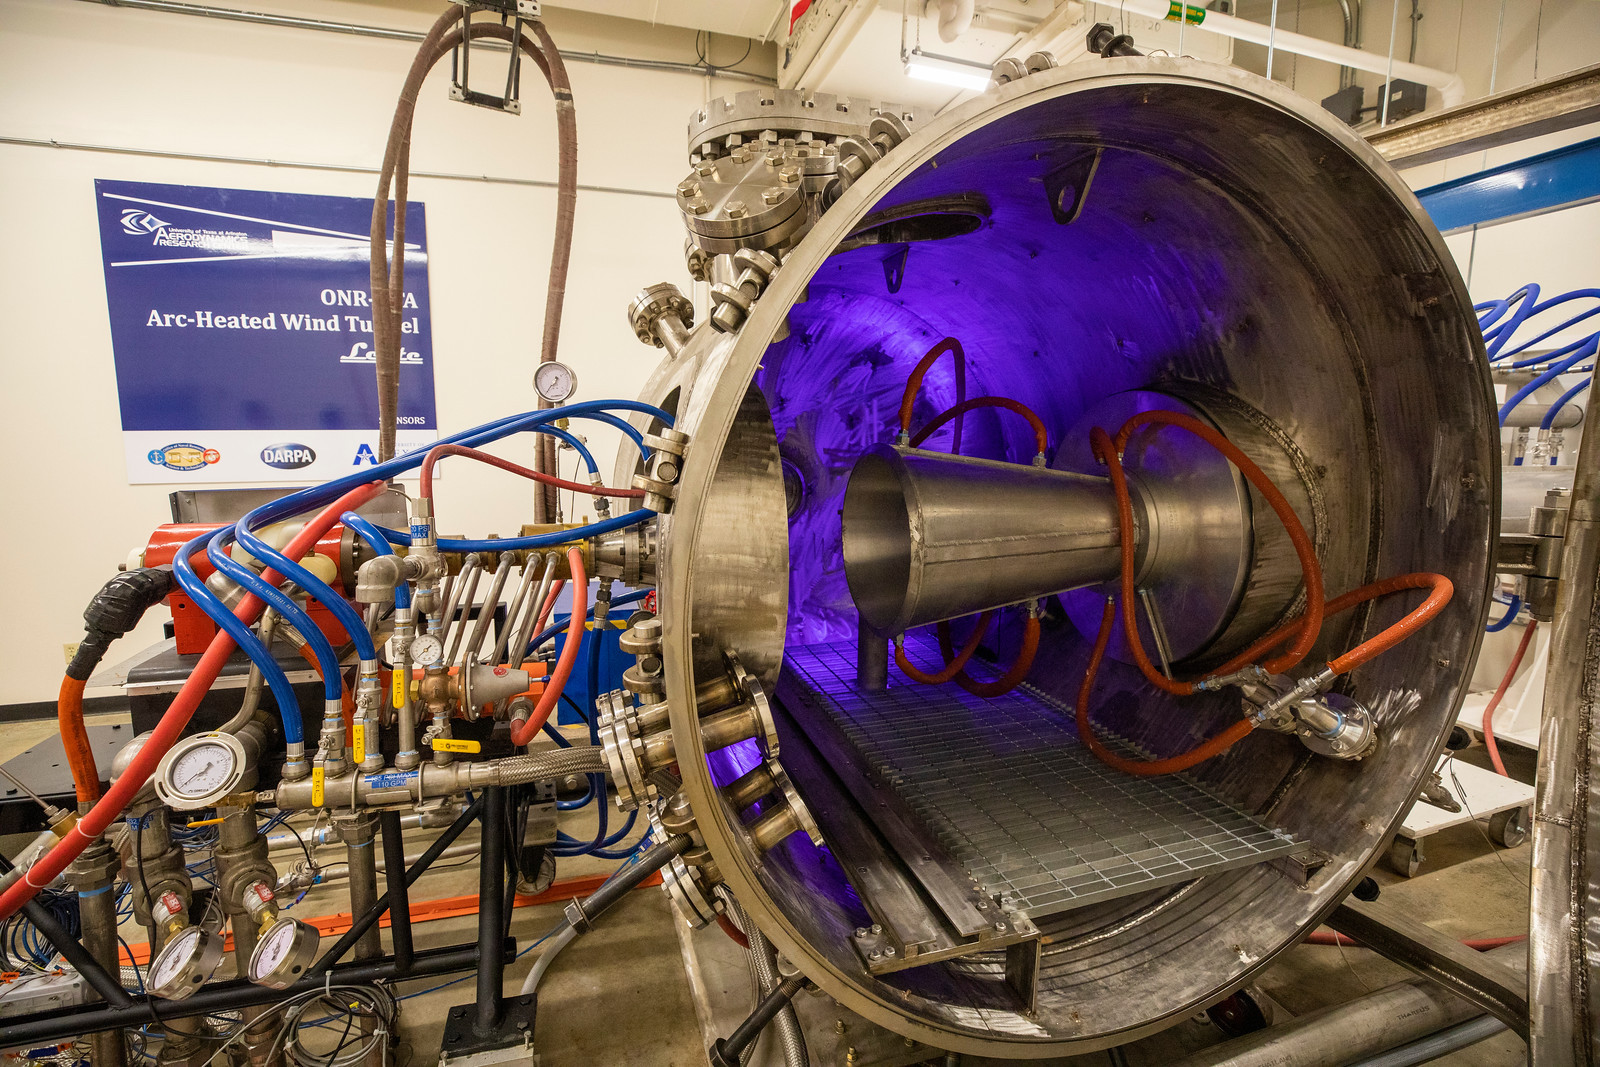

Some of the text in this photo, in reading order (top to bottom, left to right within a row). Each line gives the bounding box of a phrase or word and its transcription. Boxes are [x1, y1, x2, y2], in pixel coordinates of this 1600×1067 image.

[168, 227, 194, 235] University
[320, 289, 419, 309] ONR-A
[146, 309, 420, 334] Arc-Heated Wind Tuel
[263, 449, 313, 463] DARPA
[390, 779, 407, 787] GPM
